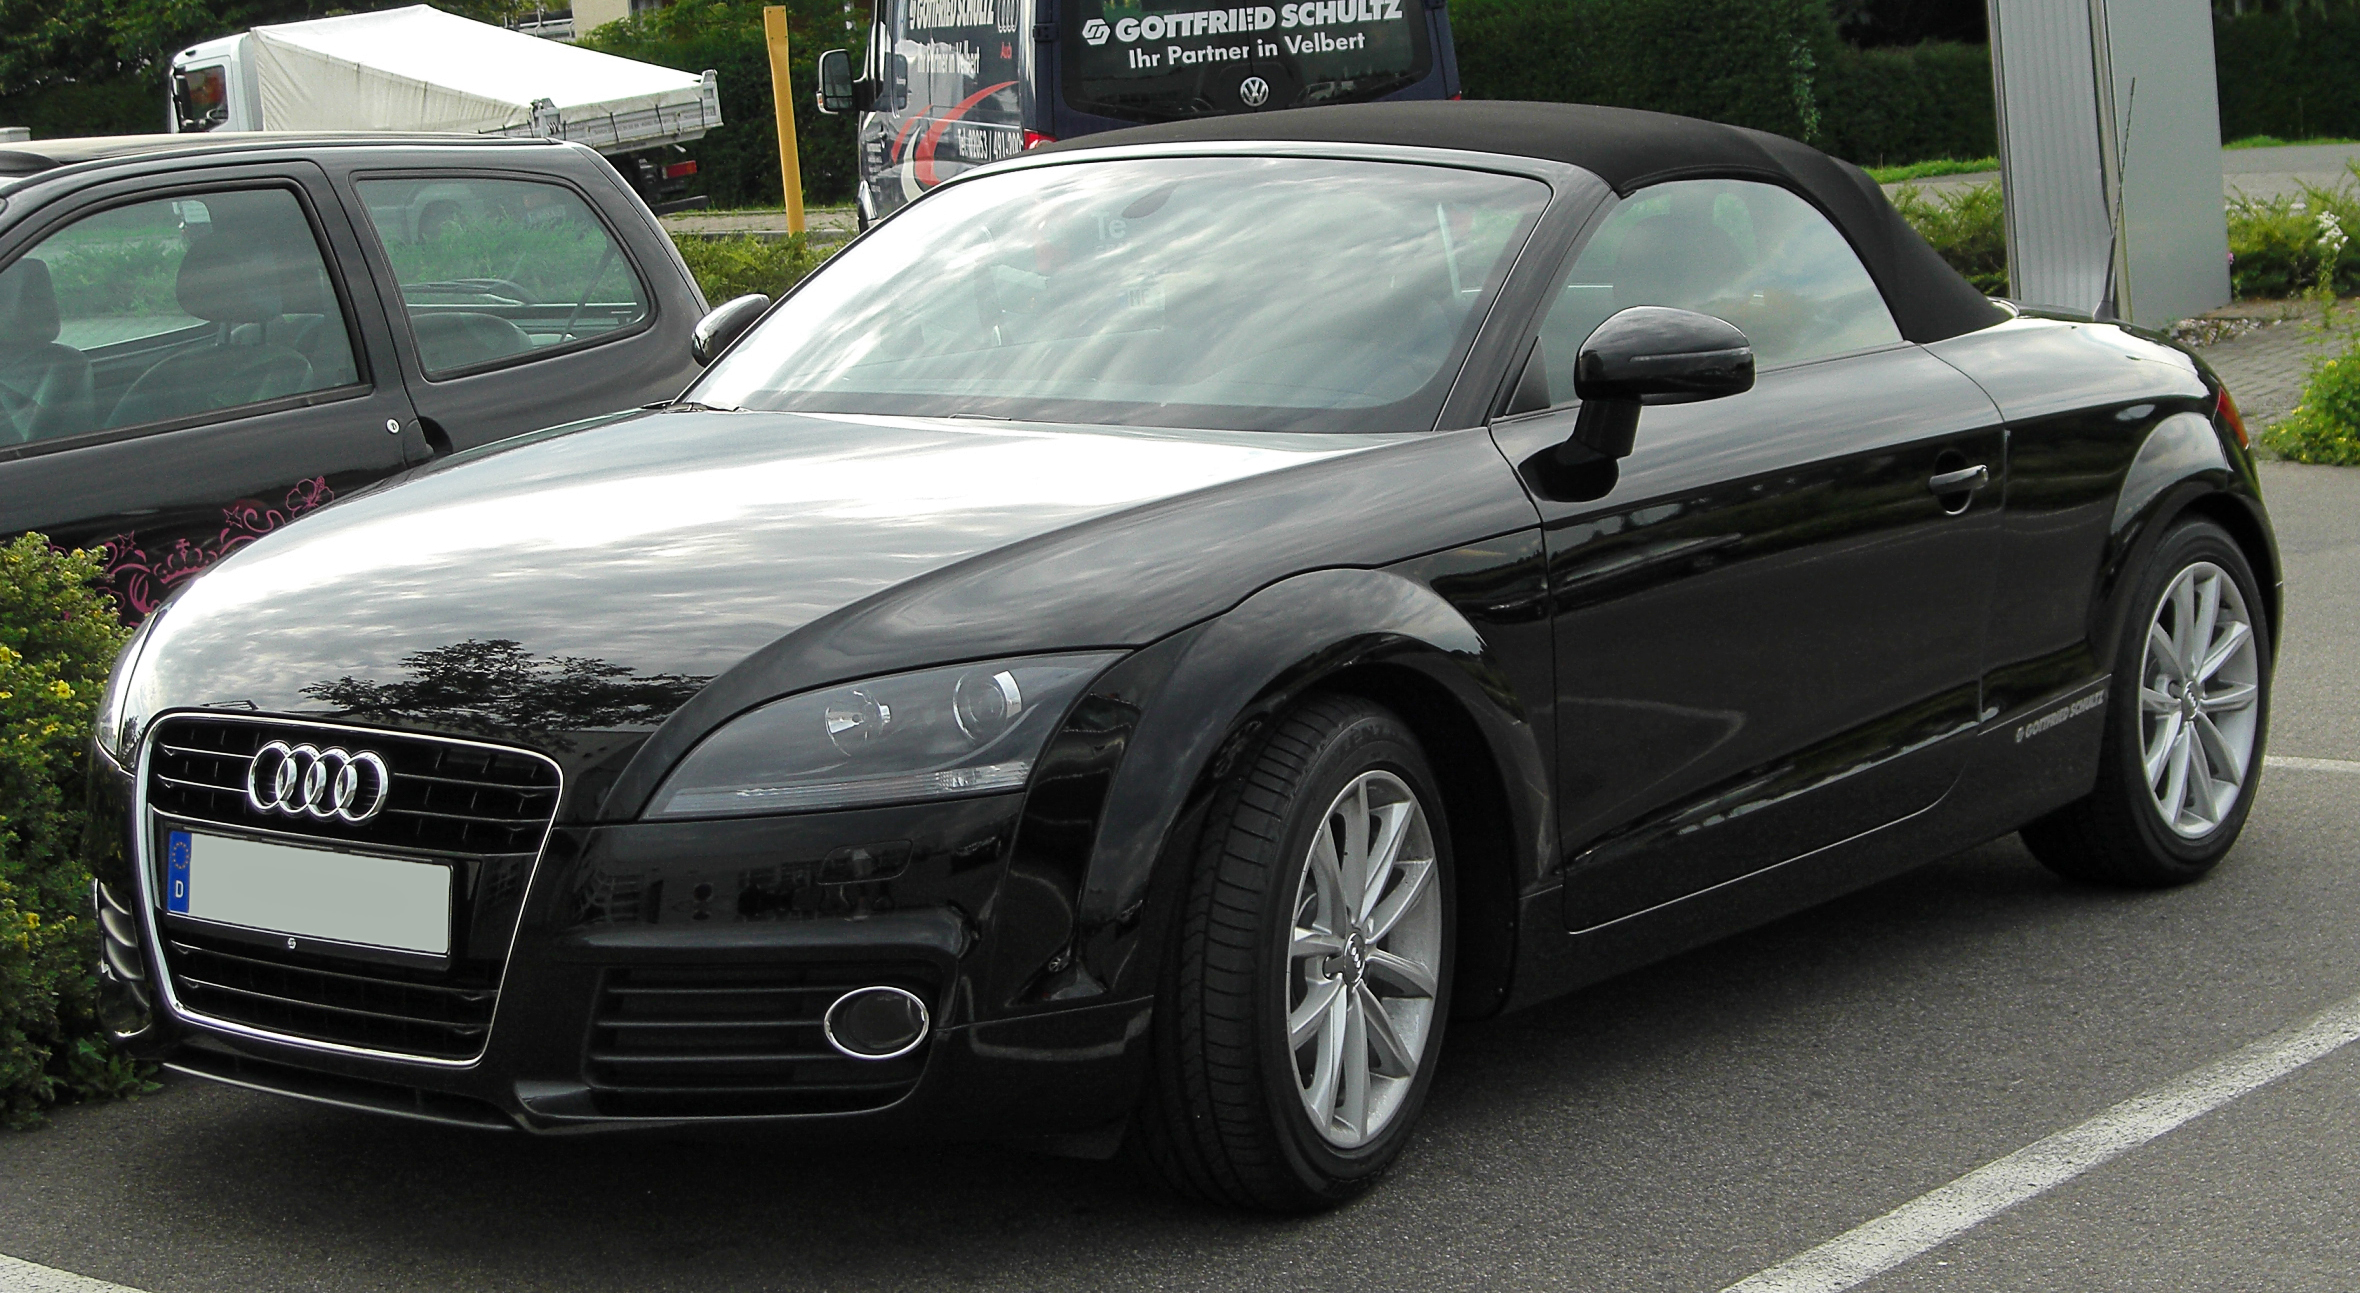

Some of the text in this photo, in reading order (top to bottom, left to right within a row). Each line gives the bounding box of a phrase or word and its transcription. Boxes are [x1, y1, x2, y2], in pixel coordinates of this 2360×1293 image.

[1115, 0, 1403, 43] GOTTFRIED SCHULTZ
[1129, 32, 1366, 69] Ihr Partner in Velbert
[2025, 689, 2105, 739] GOTTFRIED SCHULTZ
[175, 880, 184, 898] D
